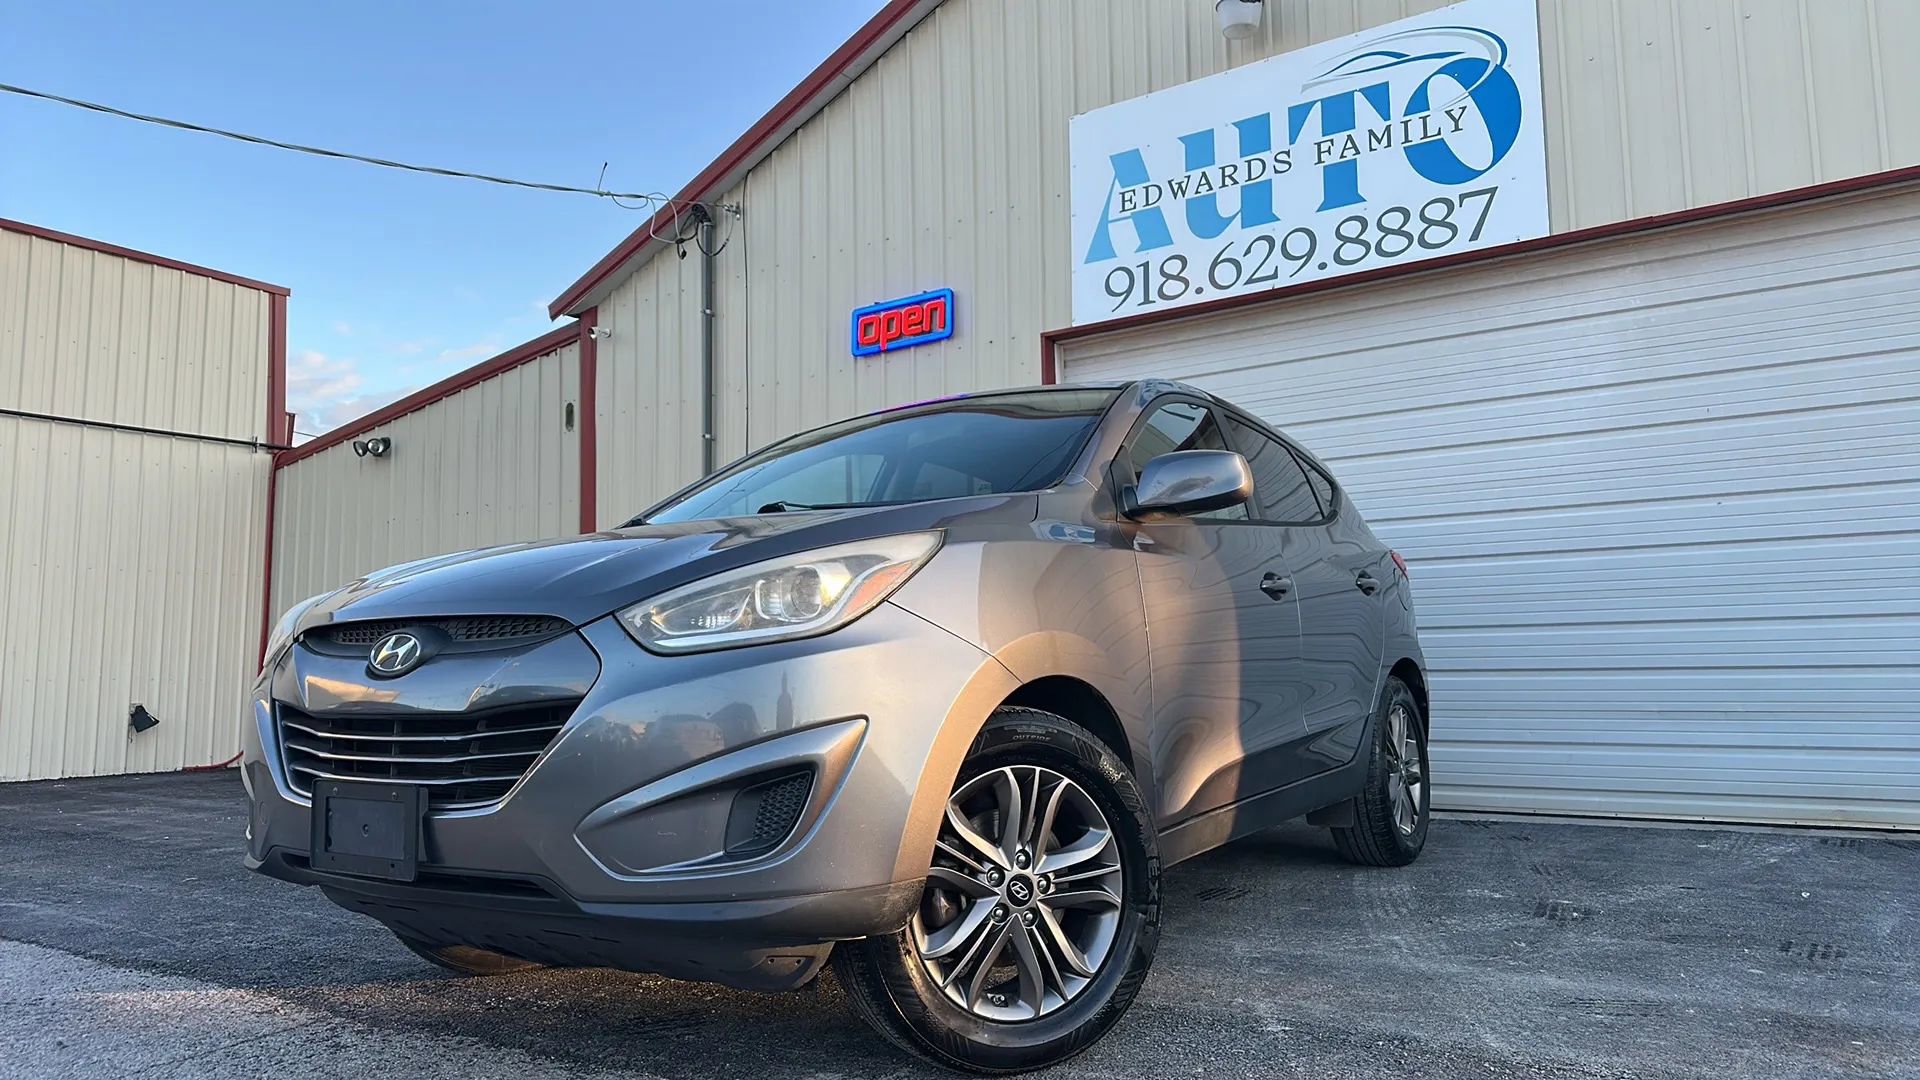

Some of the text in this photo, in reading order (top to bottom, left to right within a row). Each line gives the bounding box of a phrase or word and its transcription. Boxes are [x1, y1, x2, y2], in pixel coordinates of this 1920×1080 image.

[1083, 57, 1523, 266] AUTO
[1119, 105, 1468, 214] EDWARDS FAMILY
[1104, 186, 1499, 313] 918.629.8887
[858, 298, 946, 352] open
